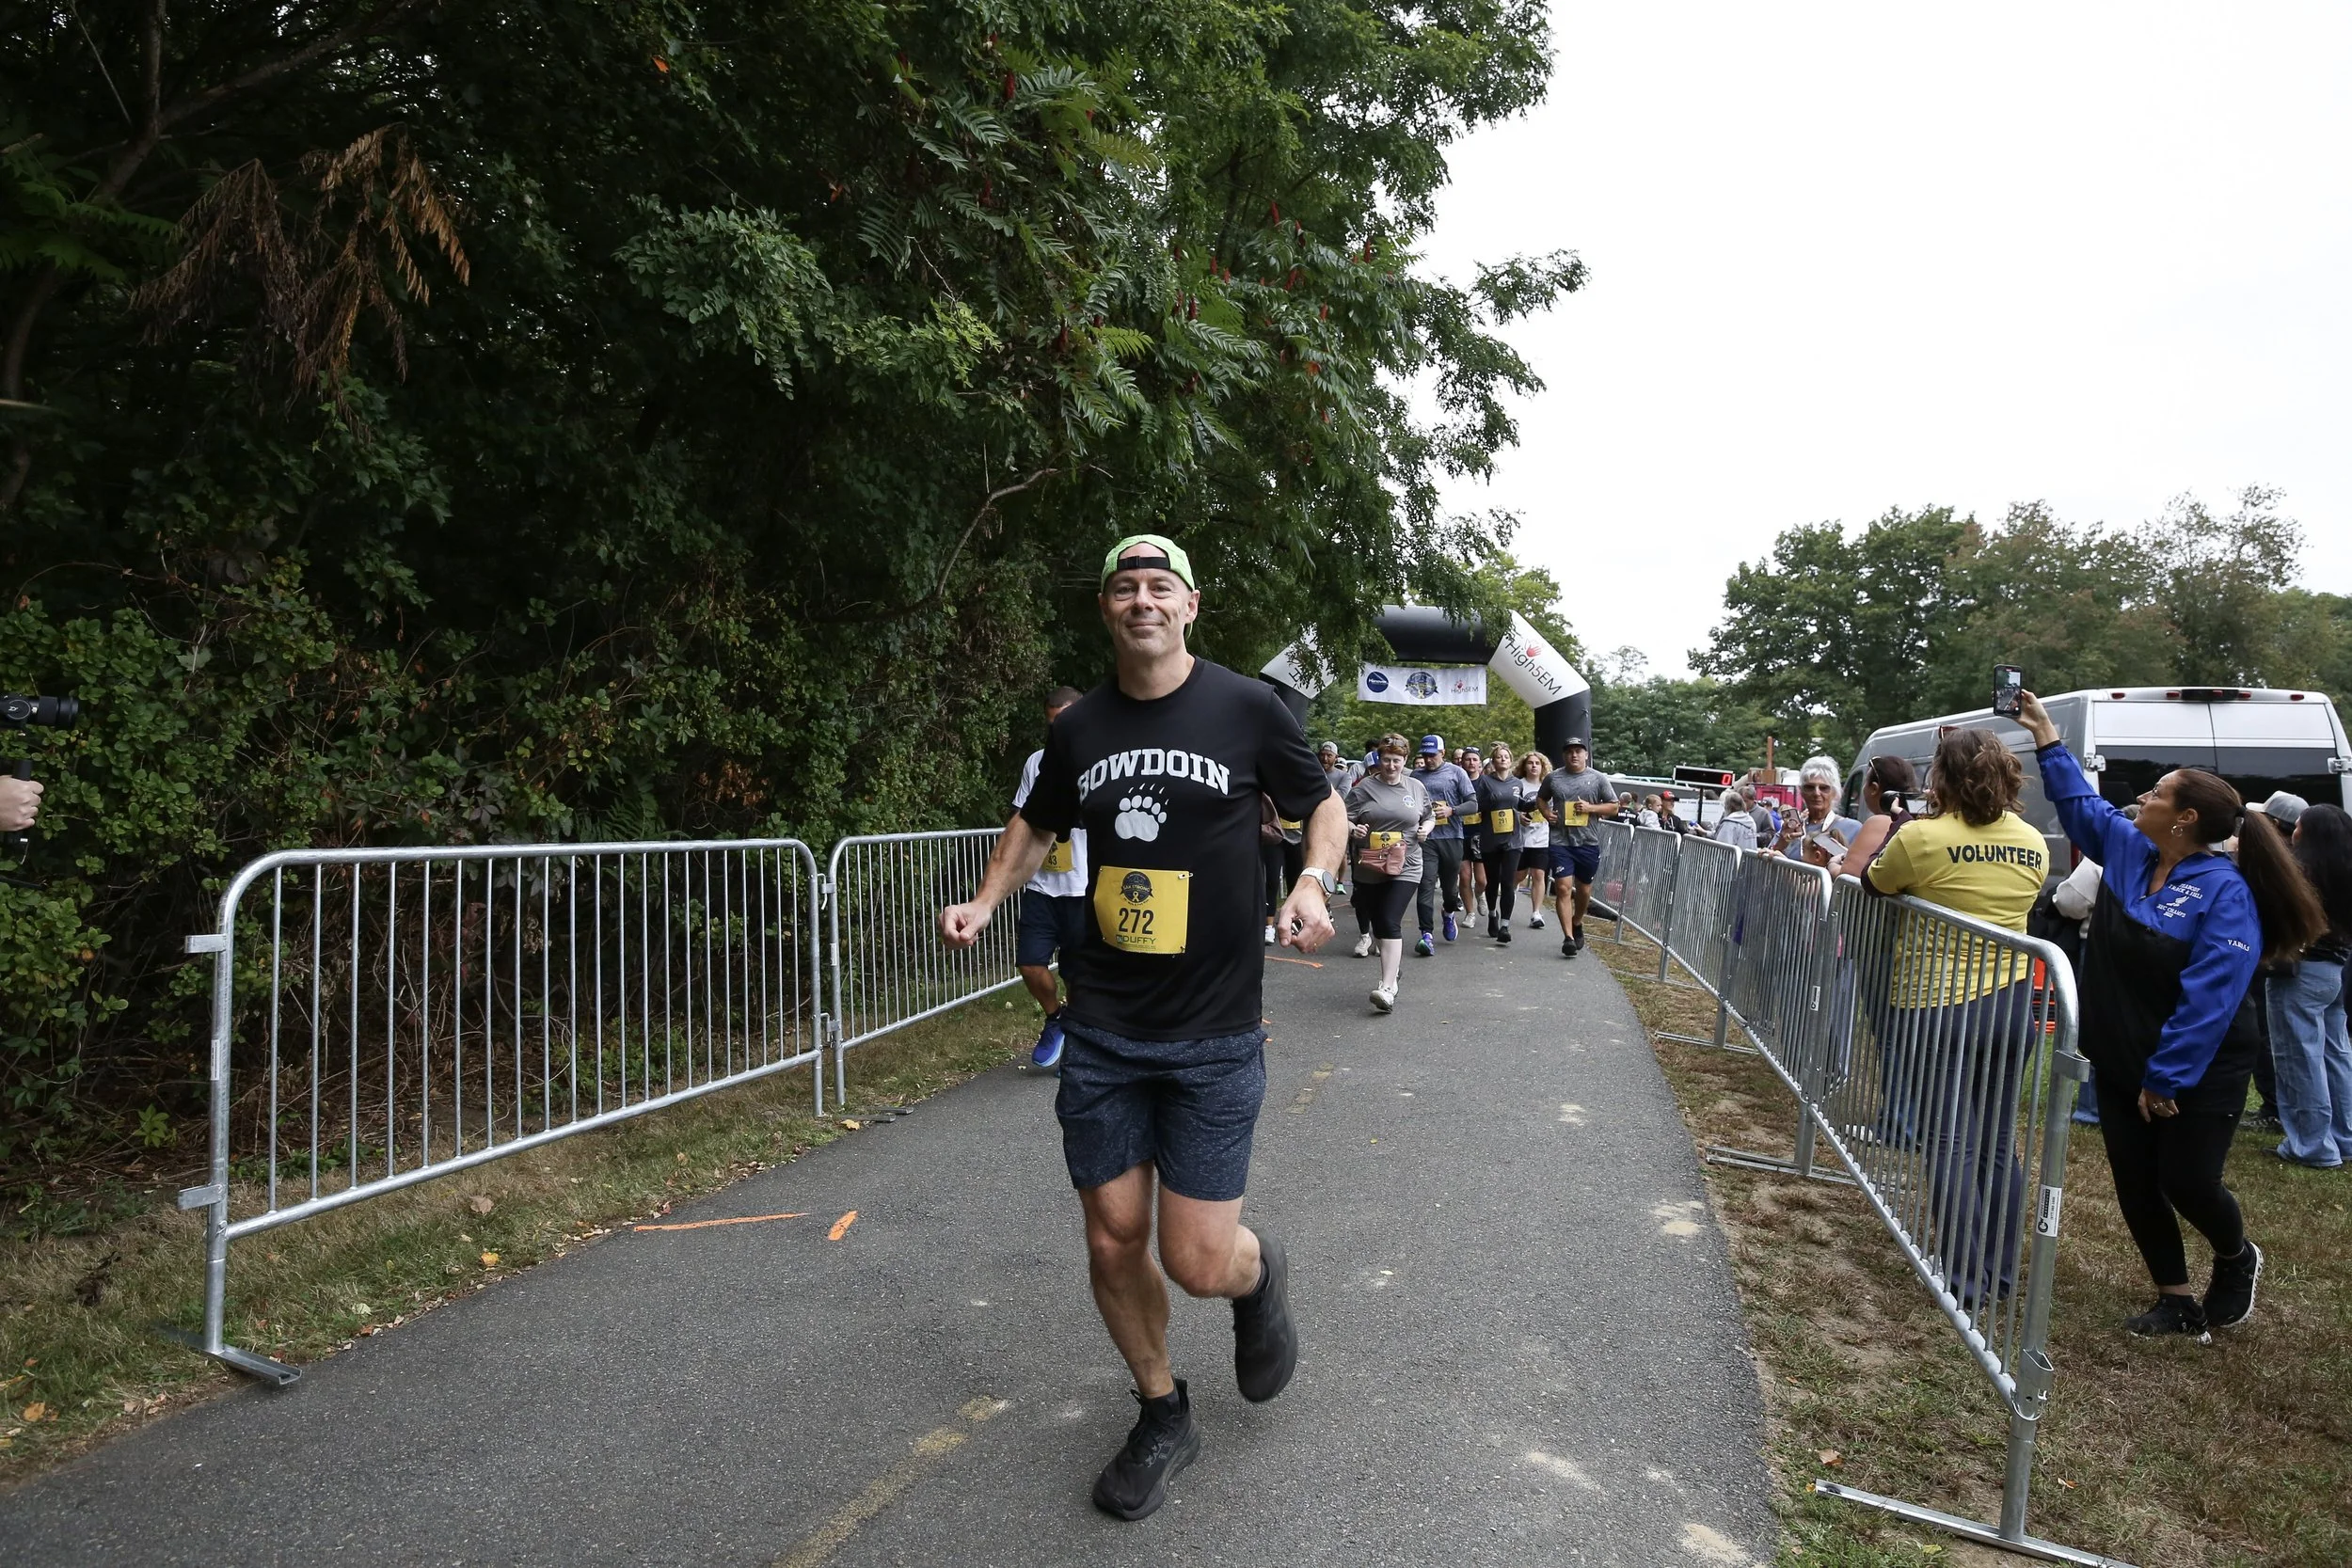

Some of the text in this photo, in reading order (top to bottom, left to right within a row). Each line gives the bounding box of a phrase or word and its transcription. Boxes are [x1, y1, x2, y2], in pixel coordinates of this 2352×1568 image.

[1505, 640, 1563, 695] High5EM
[1077, 749, 1230, 805] BOWDOIN
[1947, 845, 2042, 869] VOLUNTEER
[2169, 884, 2185, 894] TRACK
[2189, 890, 2202, 899] FIELD
[1119, 908, 1154, 934] 272
[2167, 907, 2185, 918] CHAMPS
[1122, 934, 1156, 944] DUFFY
